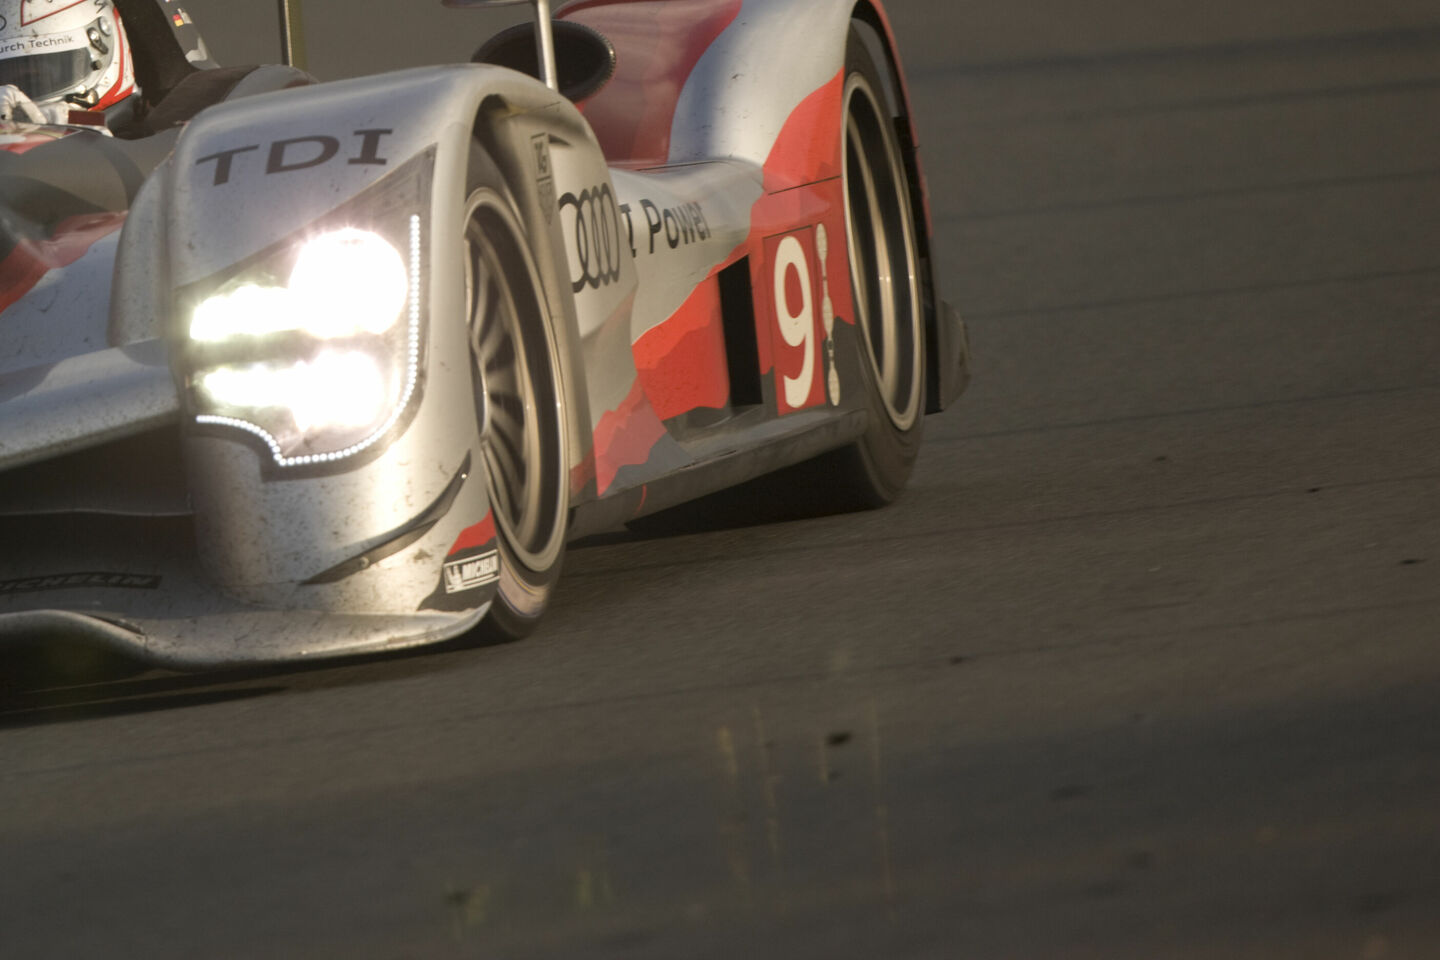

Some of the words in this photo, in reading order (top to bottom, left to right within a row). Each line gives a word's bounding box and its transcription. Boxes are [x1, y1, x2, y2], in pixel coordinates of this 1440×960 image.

[28, 34, 73, 49] Technik
[195, 128, 393, 187] TDI
[640, 198, 711, 255] Power
[774, 235, 815, 410] 9
